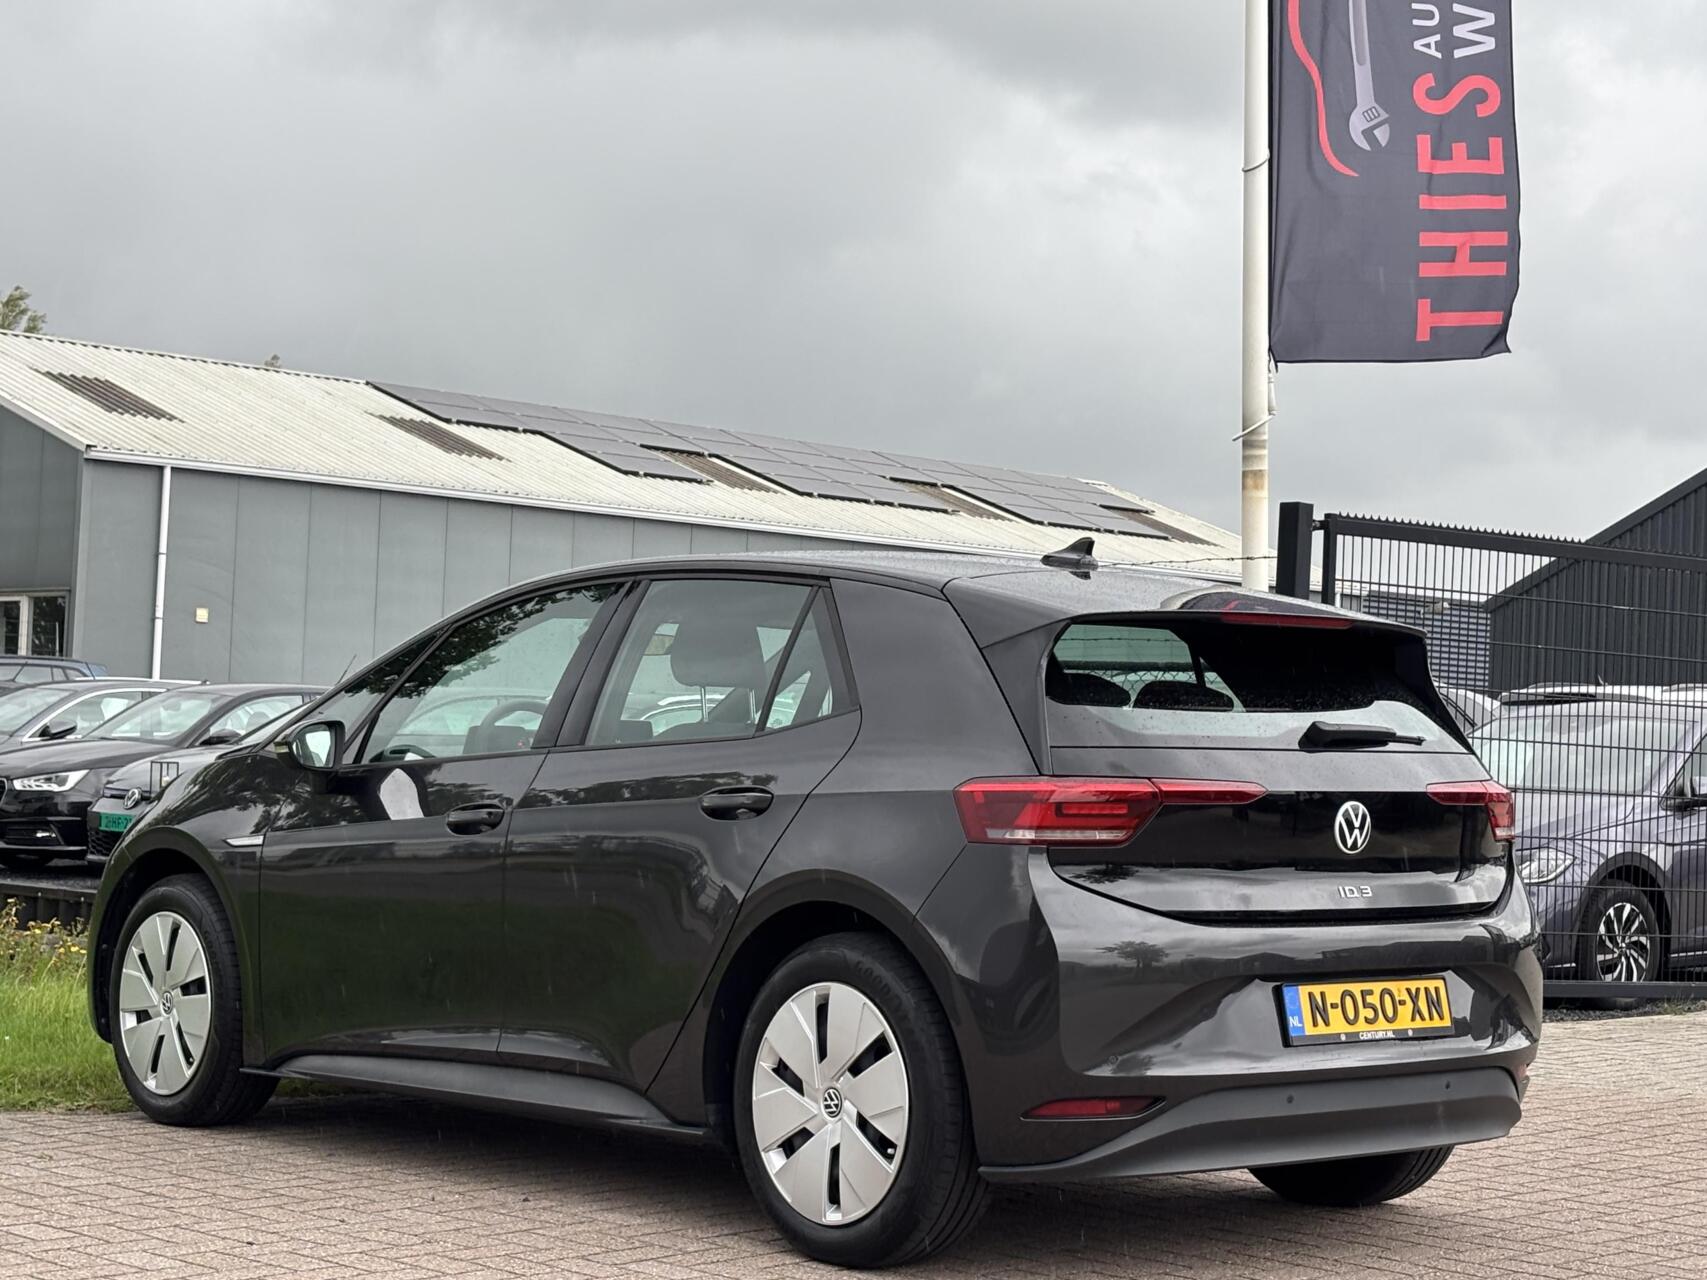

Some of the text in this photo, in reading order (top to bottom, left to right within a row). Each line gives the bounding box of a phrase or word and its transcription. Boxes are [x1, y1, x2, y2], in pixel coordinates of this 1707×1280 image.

[1412, 72, 1508, 342] THIES
[1289, 1015, 1303, 1028] NL
[1308, 986, 1445, 1028] N-050-XN
